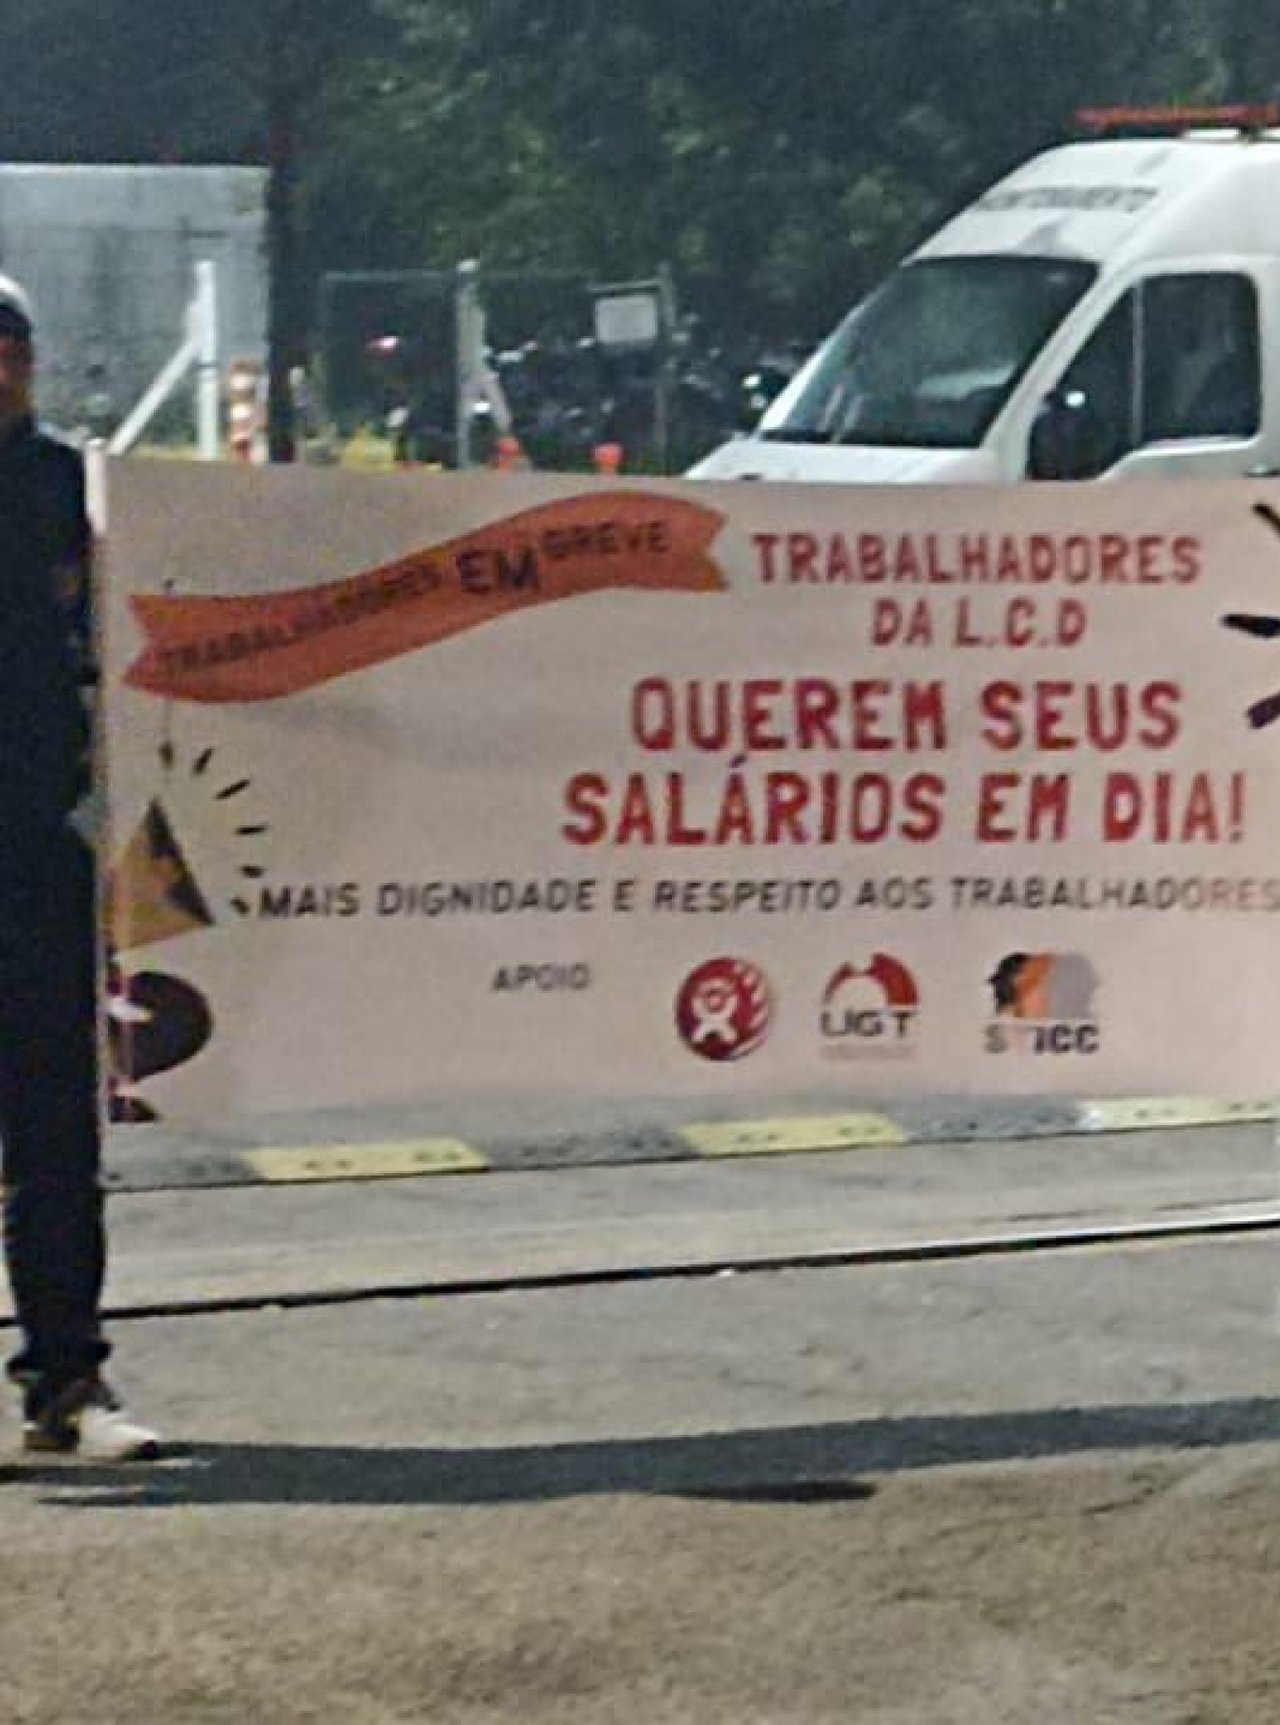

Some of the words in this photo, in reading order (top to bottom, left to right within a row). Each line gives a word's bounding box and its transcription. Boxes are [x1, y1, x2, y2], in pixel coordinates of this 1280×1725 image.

[456, 547, 540, 597] EM
[542, 520, 669, 559] GREVE
[753, 531, 1201, 585] TRABALHADORES
[871, 600, 932, 646] DA
[954, 598, 1087, 647] L.C.D
[631, 676, 947, 752] QUEREM
[980, 680, 1182, 752] SEUS
[562, 754, 944, 845] SALÁRIOS
[975, 772, 1072, 844] EM
[1104, 771, 1246, 844] DIA!
[258, 882, 359, 919] MAIS
[376, 877, 595, 915] DIGNIDADE
[614, 878, 635, 913] E
[654, 878, 838, 914] RESPEITO
[855, 877, 934, 911] AOS
[493, 962, 589, 992] APOIO
[819, 1009, 918, 1038] UGT
